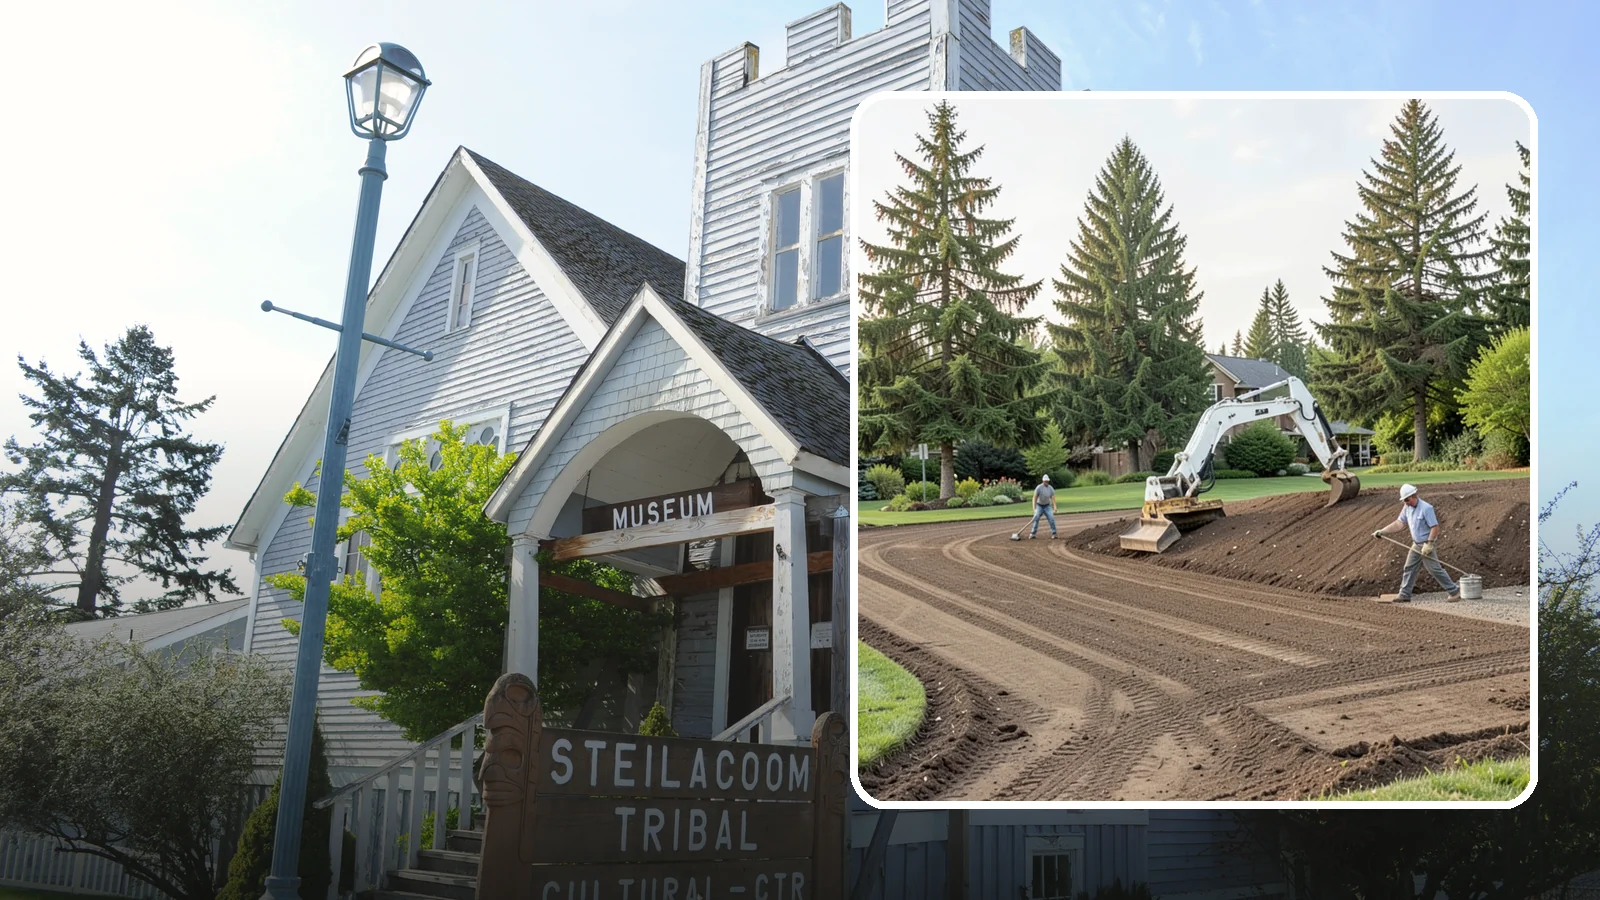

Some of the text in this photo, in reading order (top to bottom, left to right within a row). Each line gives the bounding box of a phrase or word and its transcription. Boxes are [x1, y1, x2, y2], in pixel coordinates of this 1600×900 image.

[613, 491, 714, 531] MUSEUM
[550, 738, 810, 793] STEILACOOM
[615, 806, 758, 852] TRIBAL
